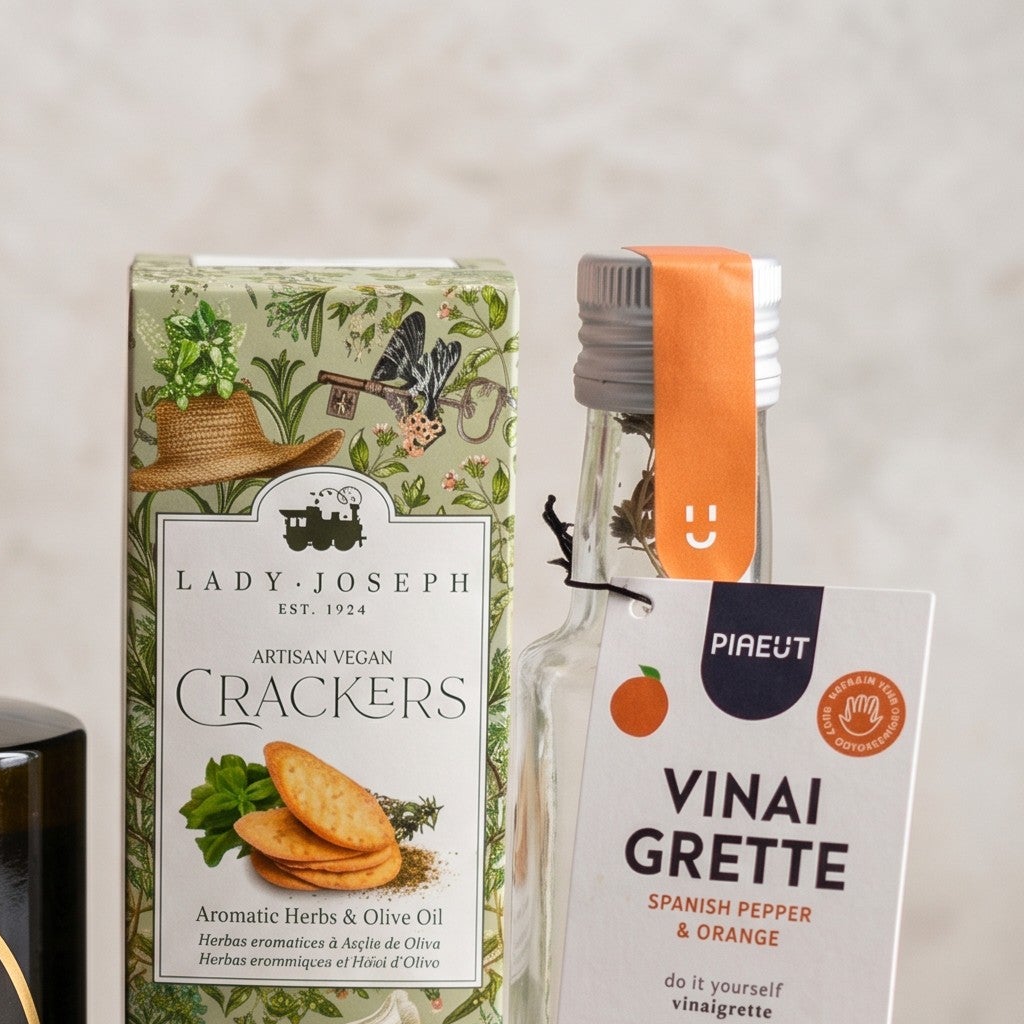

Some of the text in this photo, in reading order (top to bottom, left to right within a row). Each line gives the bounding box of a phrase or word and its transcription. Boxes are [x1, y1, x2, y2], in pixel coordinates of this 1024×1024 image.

[176, 570, 470, 594] LADY JOSEPH
[278, 603, 366, 616] EST. 1924
[252, 649, 393, 665] ARTISAN VEGAN
[664, 767, 821, 825] VINAI
[624, 827, 849, 891] GRETTE
[195, 905, 443, 926] Aromatic Herbs & Olive Oil
[648, 893, 812, 923] SPANISH PEPPER
[198, 933, 247, 948] Herbas
[384, 937, 401, 950] de
[404, 937, 441, 950] Oliva
[677, 922, 780, 947] & ORANGE
[198, 952, 247, 967] Herbas
[664, 972, 784, 998] do it yourself
[672, 996, 773, 1019] vinaigrette
